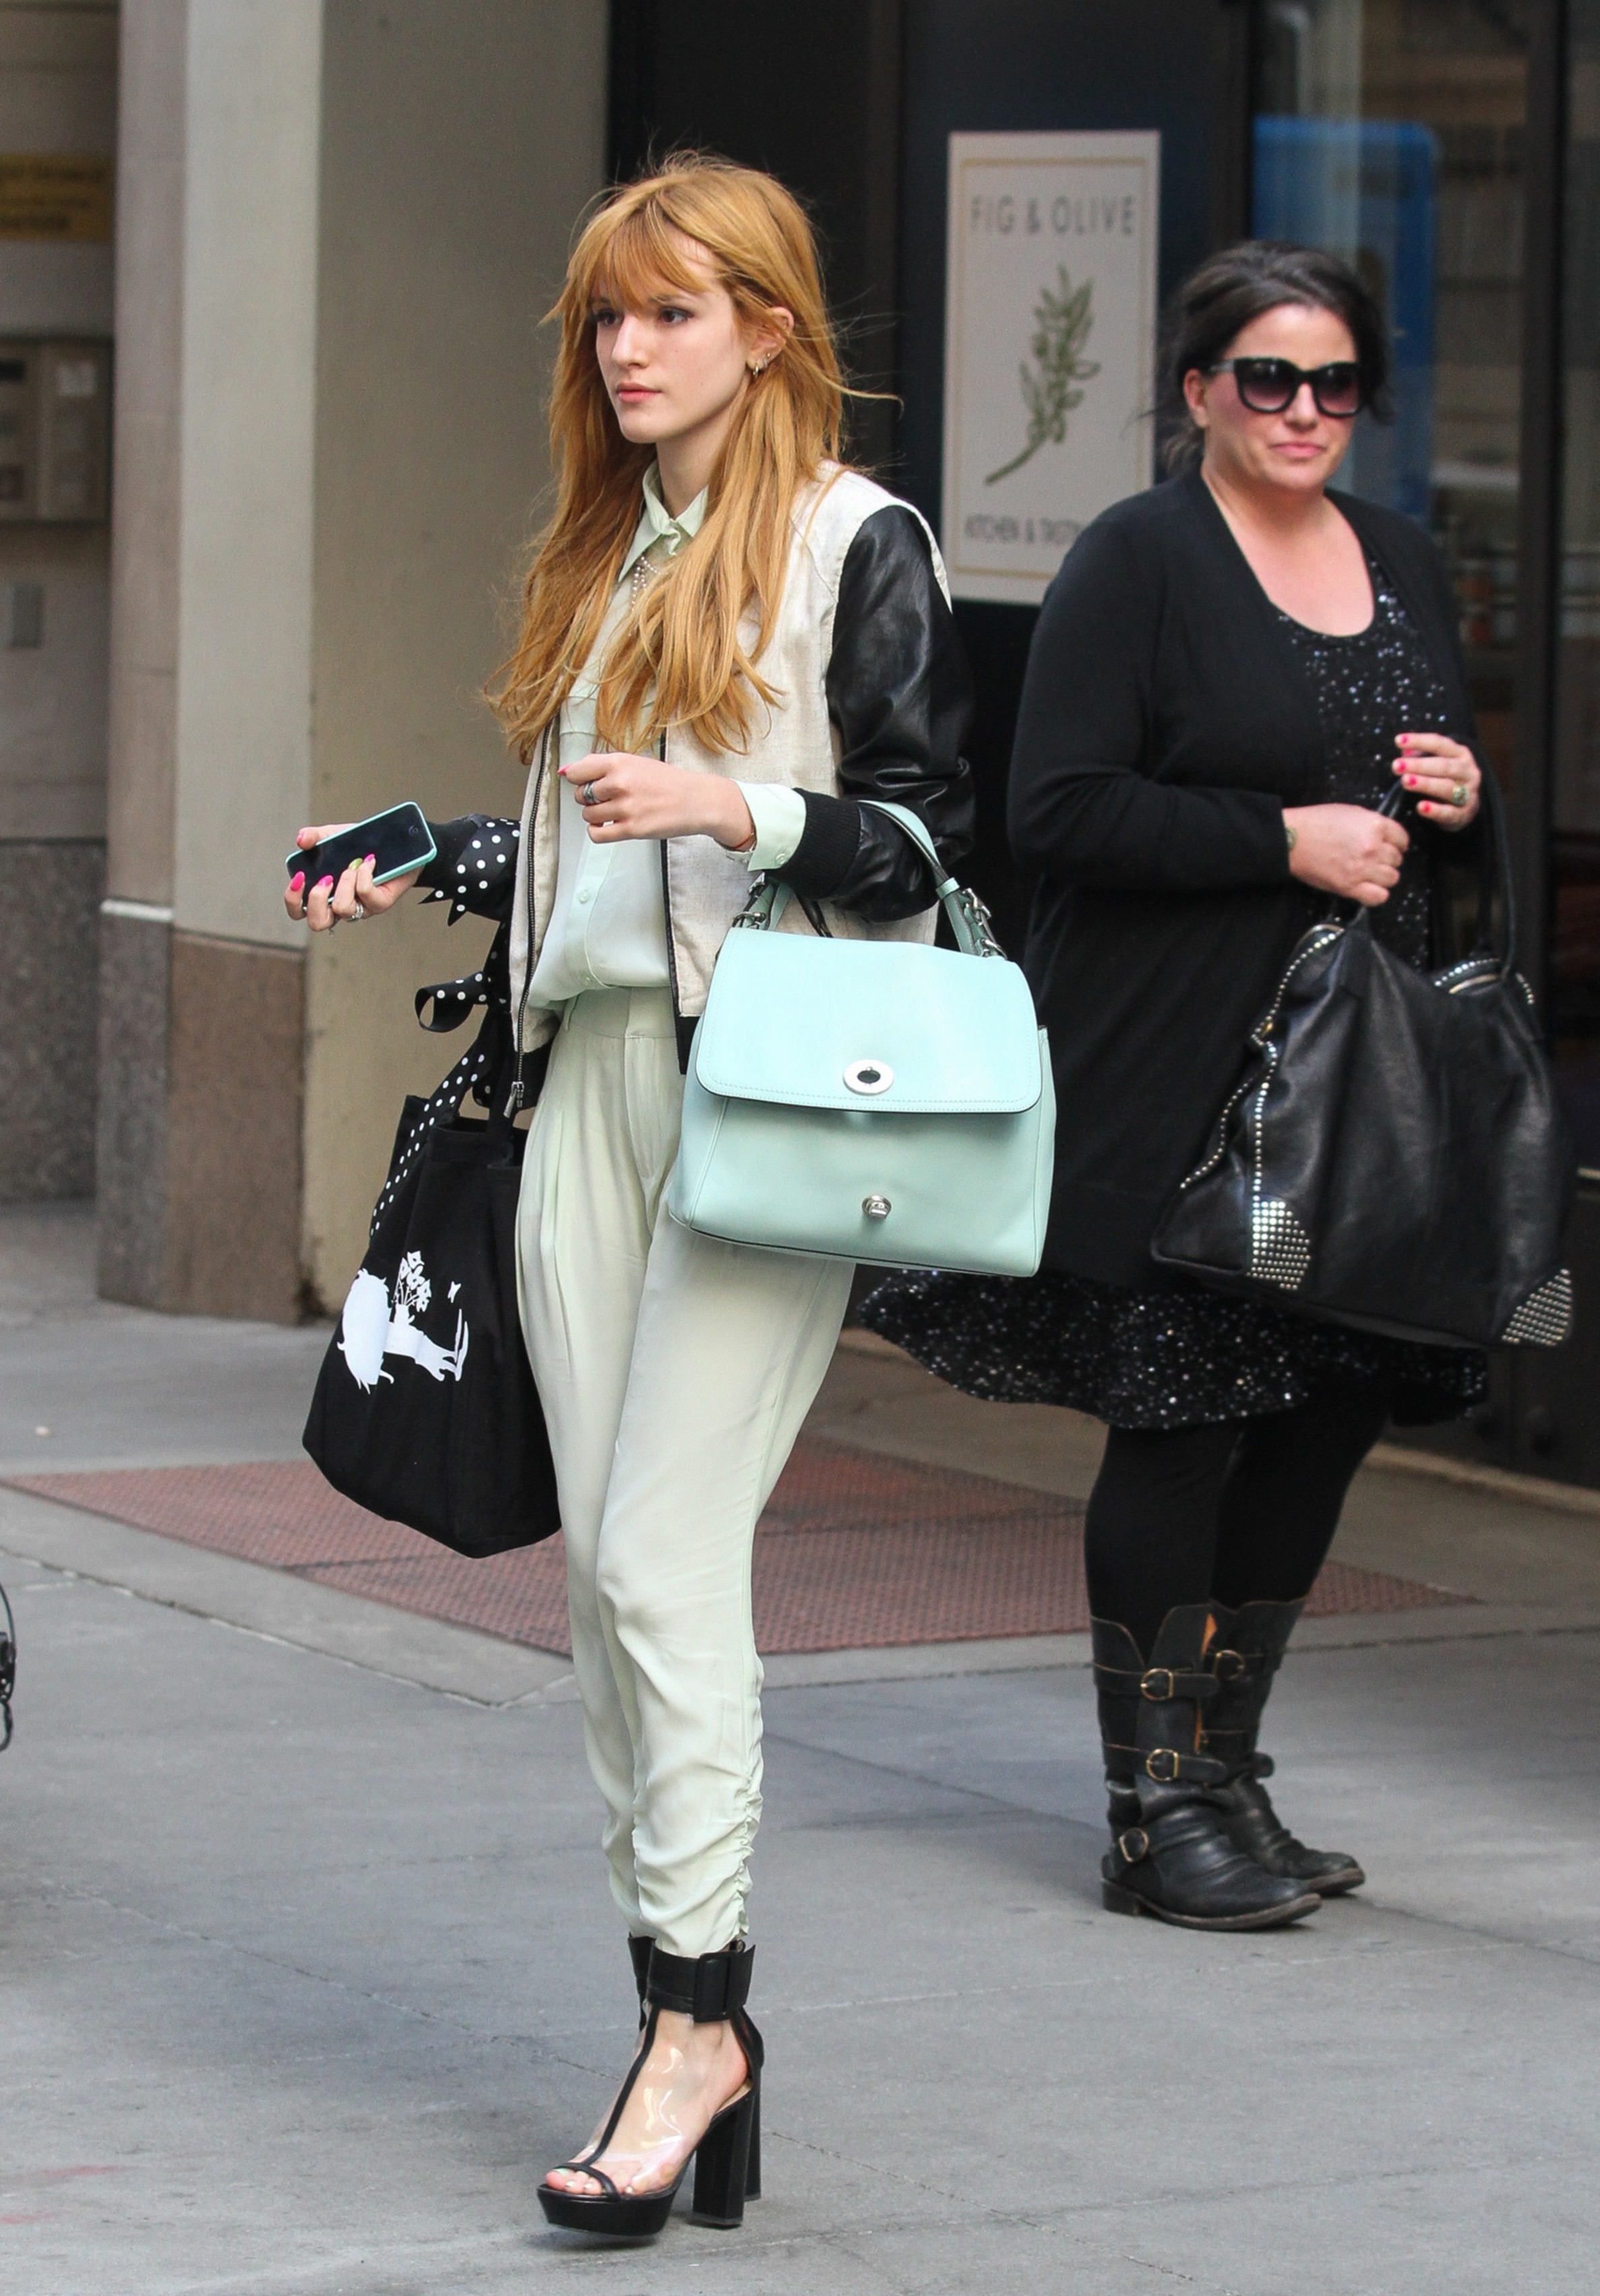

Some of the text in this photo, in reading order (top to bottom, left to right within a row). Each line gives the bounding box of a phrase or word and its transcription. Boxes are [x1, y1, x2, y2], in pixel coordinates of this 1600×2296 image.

[971, 194, 1135, 236] FIG & OLIVE
[1025, 517, 1036, 545] &
